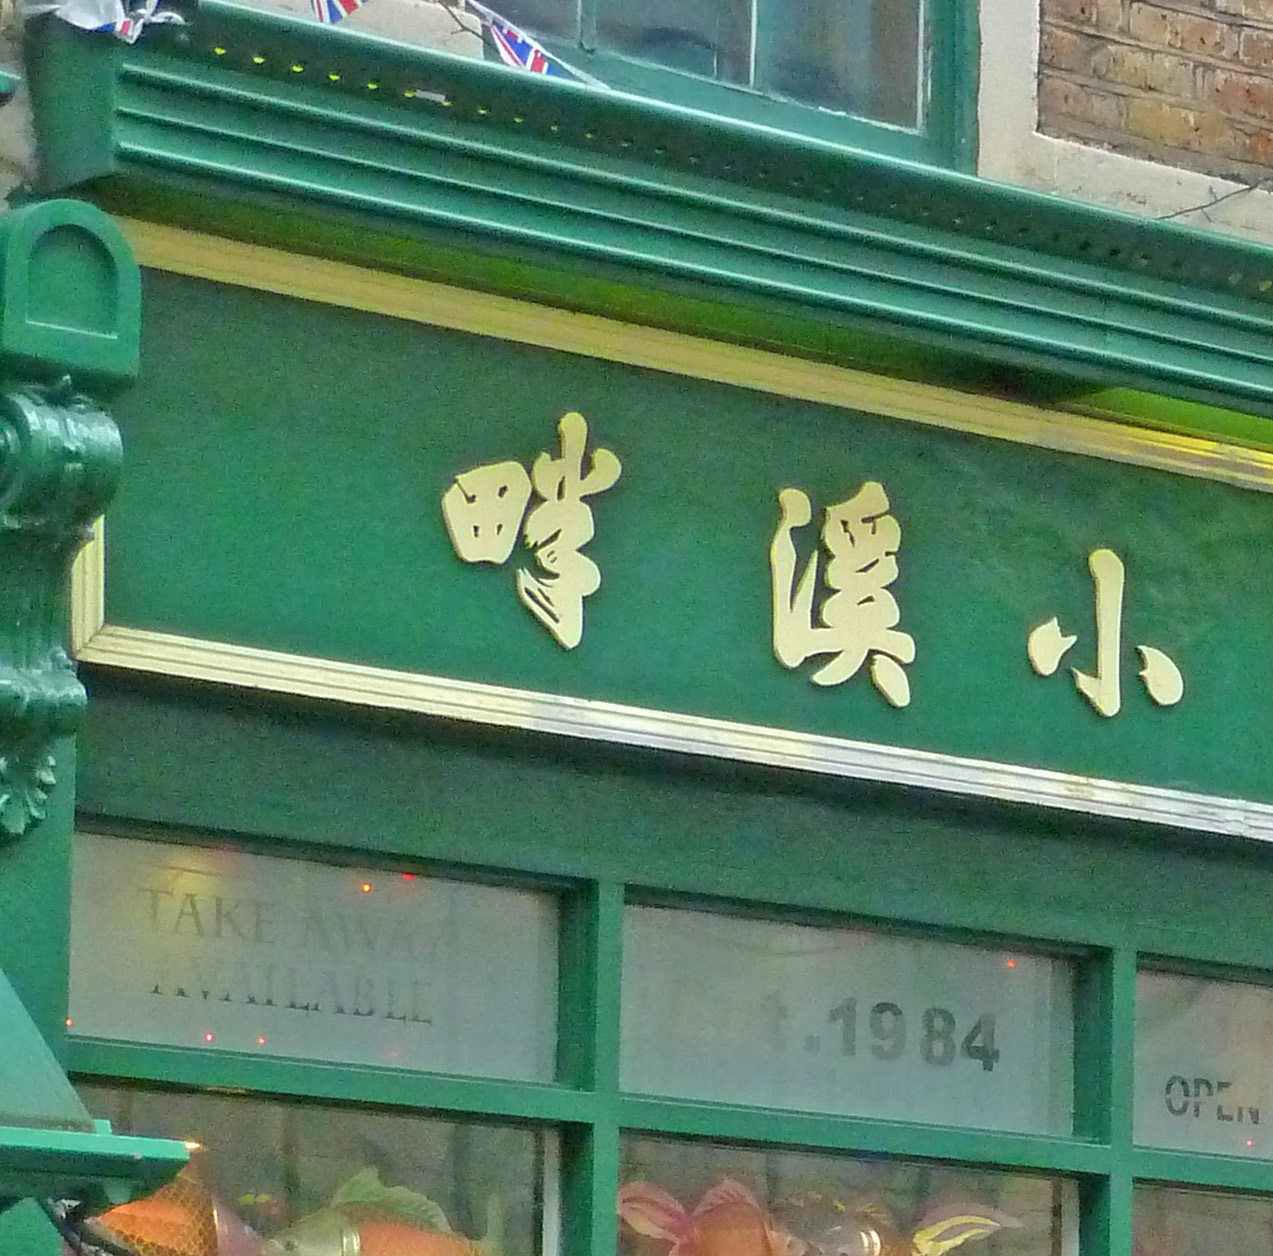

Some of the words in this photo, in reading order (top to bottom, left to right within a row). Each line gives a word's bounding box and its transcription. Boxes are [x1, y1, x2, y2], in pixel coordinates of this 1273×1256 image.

[138, 888, 274, 942] TAKE
[828, 997, 1000, 1072] 1984
[1164, 1076, 1259, 1124] OPEN
